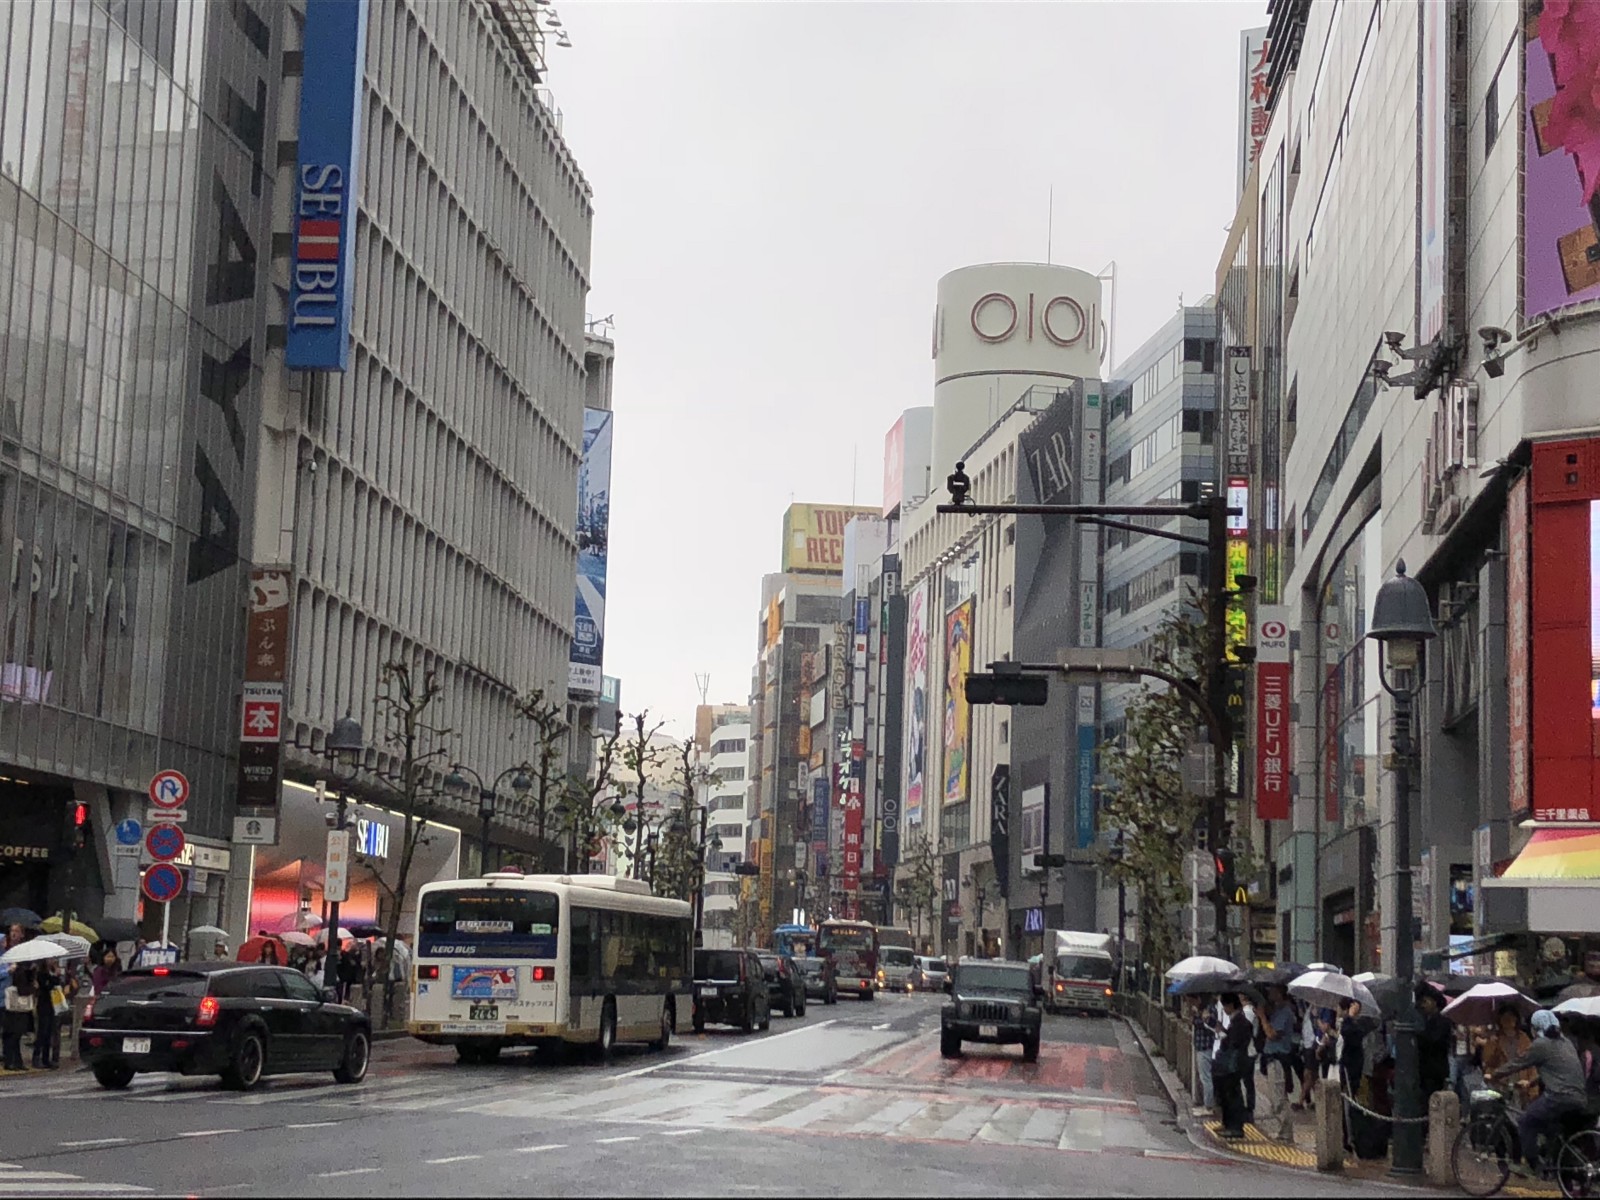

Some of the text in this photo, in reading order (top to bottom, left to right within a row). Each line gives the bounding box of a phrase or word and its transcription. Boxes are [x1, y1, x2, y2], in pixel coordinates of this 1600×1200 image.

[294, 163, 343, 326] SEIBU
[1030, 423, 1075, 505] ZAR
[244, 687, 283, 696] TSUTAYA
[248, 706, 275, 733] 本
[1264, 676, 1282, 792] 三菱UFJ銀行
[243, 766, 273, 775] WIRED
[993, 776, 1007, 835] ZARA
[1535, 809, 1590, 820] 三千里薬品
[356, 819, 389, 858] SEIBU
[1025, 908, 1043, 931] ZARA
[431, 945, 476, 954] KEIO BUS
